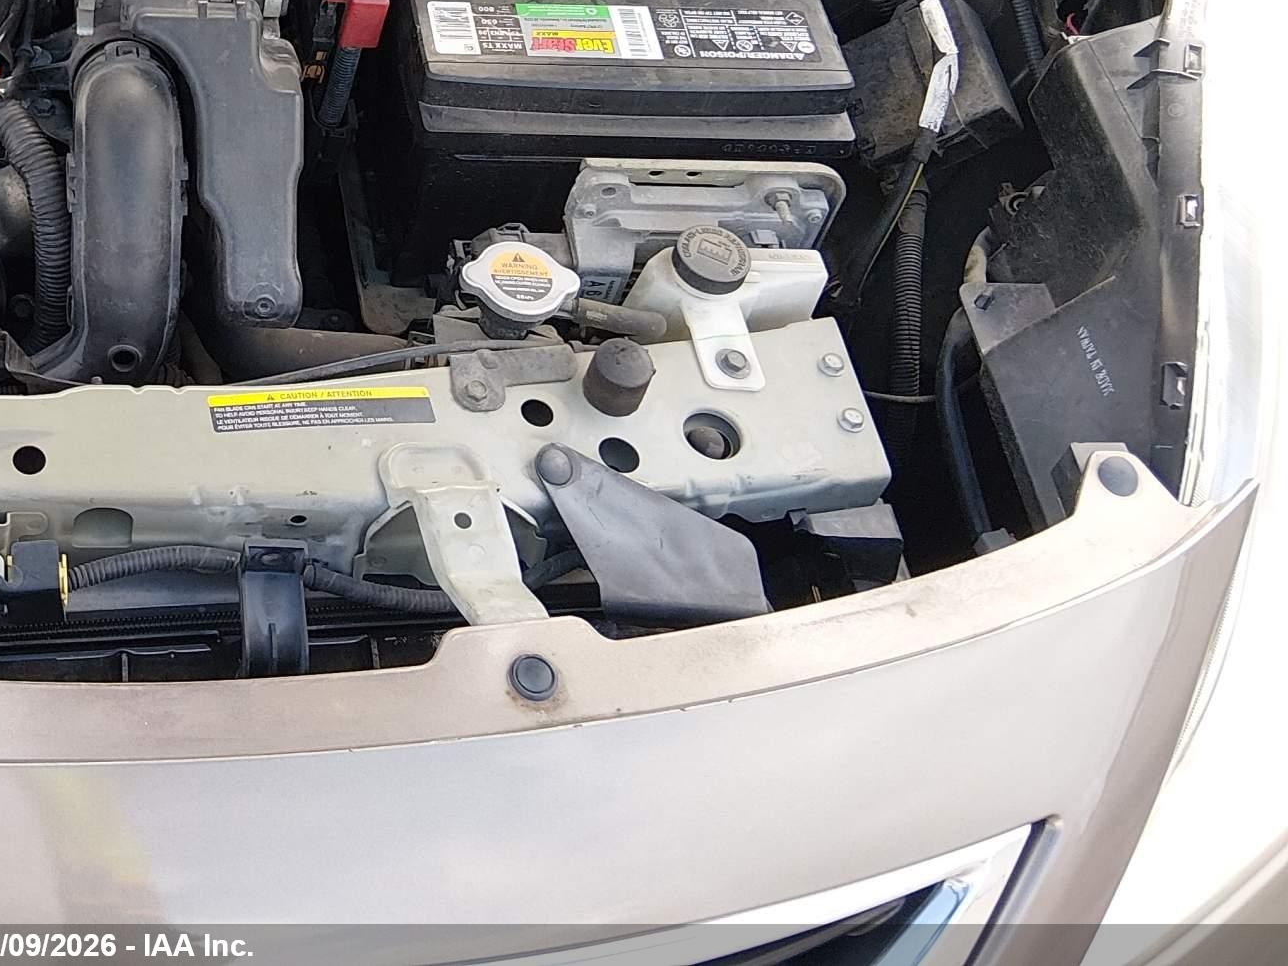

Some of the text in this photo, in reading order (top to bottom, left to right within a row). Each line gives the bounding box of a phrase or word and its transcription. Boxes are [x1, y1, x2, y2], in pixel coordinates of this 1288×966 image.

[529, 37, 615, 55] EverStart
[501, 262, 538, 271] WARNING
[1077, 326, 1097, 359] TAIWAN
[279, 391, 318, 400] CAUTION
